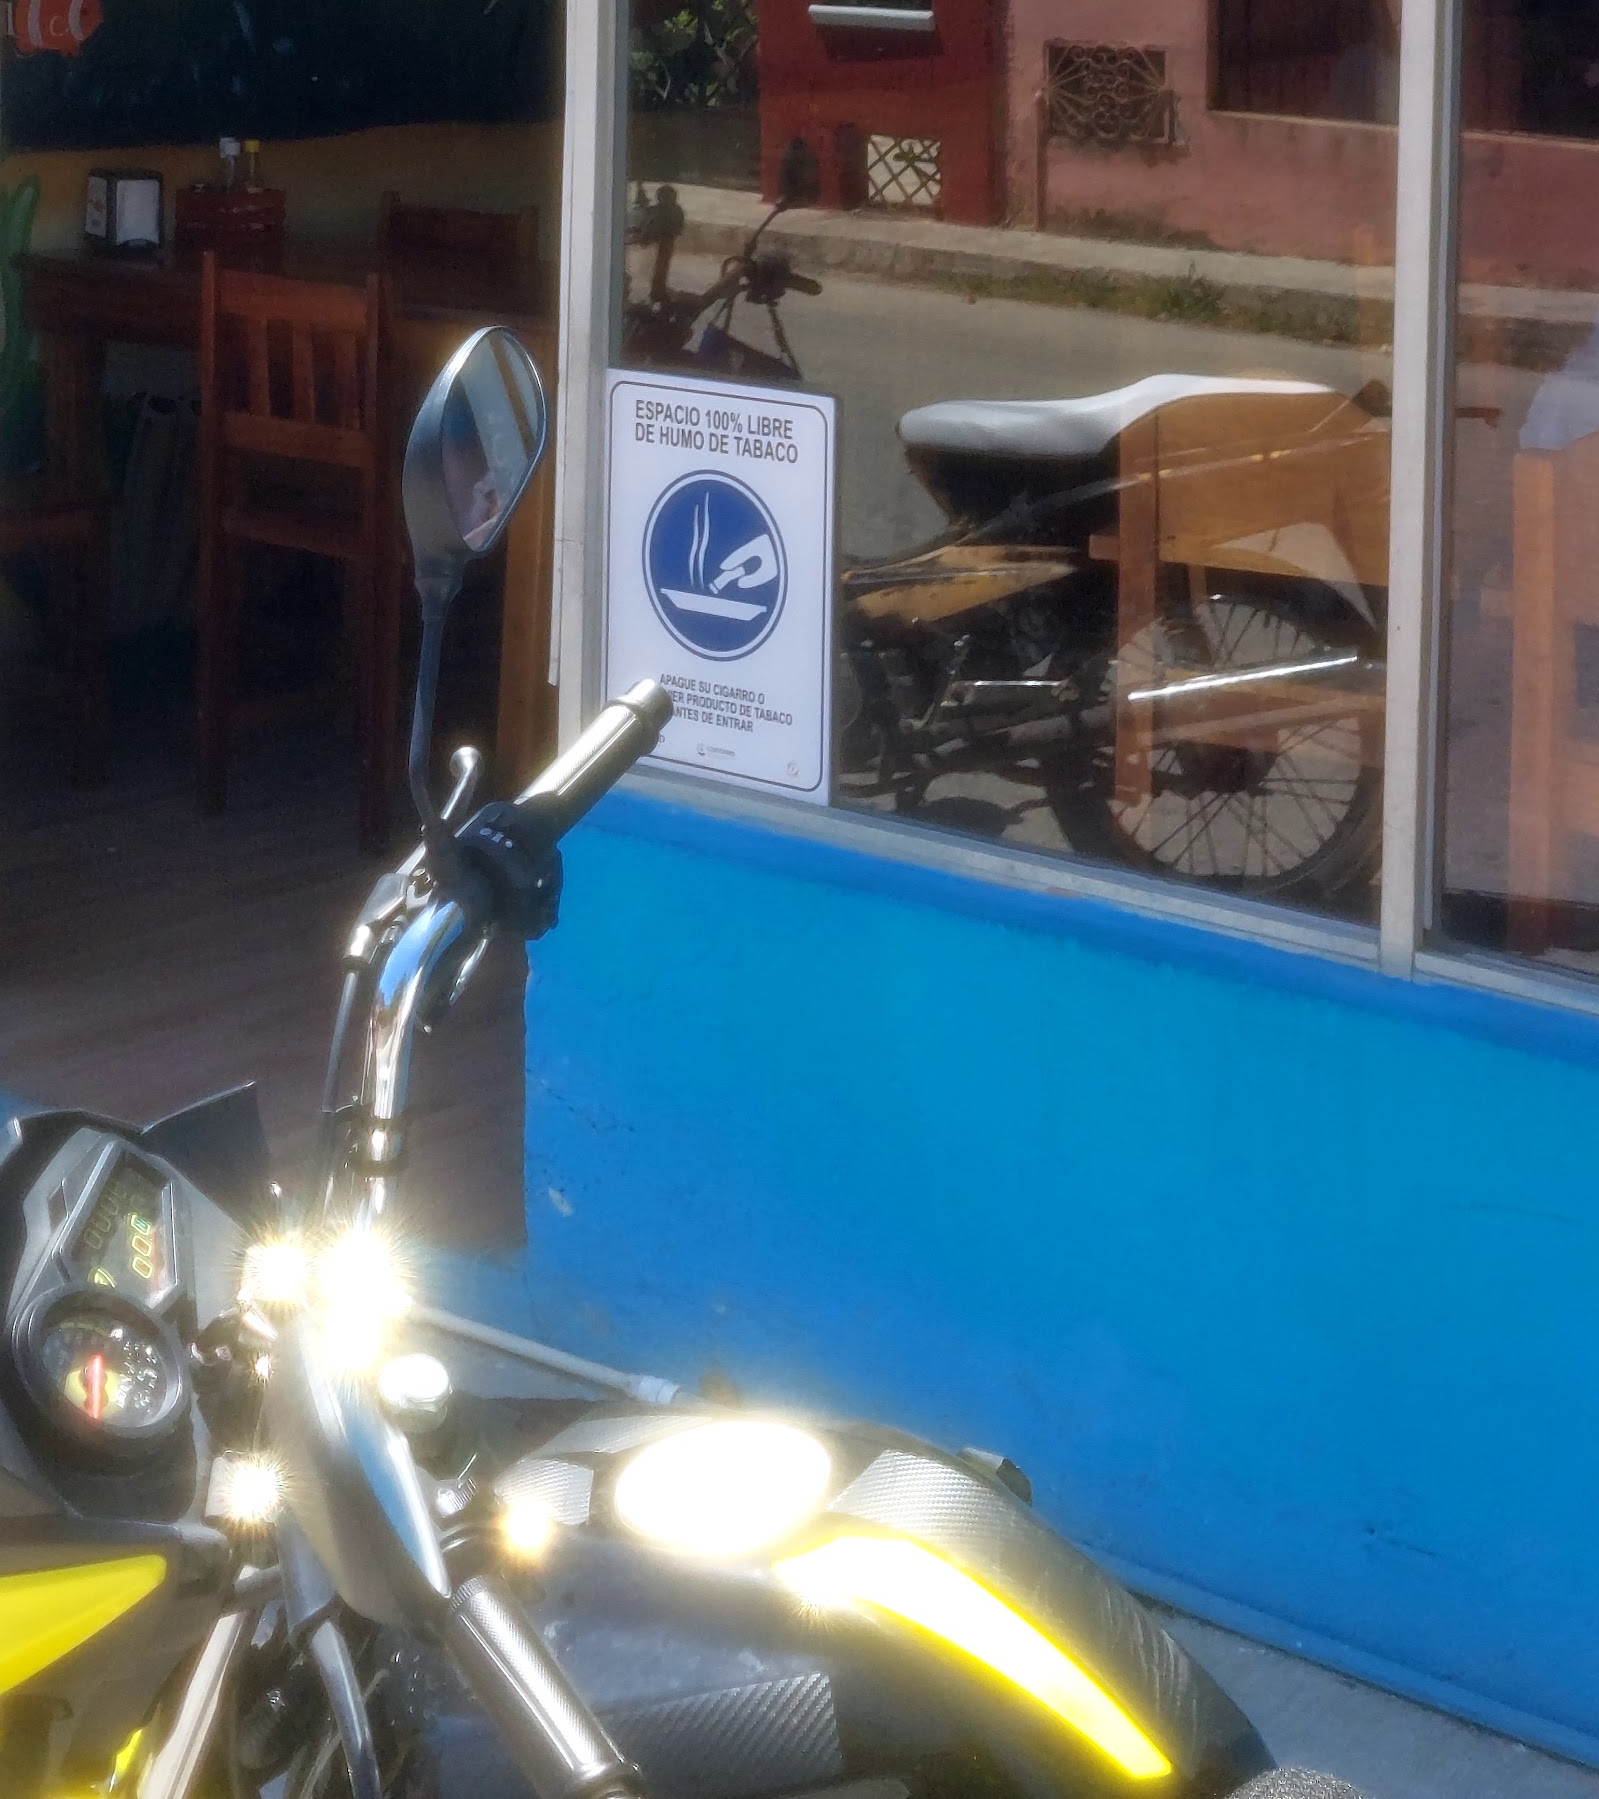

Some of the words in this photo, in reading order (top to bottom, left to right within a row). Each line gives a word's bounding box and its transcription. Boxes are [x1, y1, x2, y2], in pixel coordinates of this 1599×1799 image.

[635, 399, 700, 426] ESPACIO
[705, 410, 743, 433] 100%
[747, 415, 794, 440] LIBRE
[635, 422, 655, 444] DE
[659, 425, 705, 450] HUMO
[709, 433, 729, 454] DE
[733, 436, 799, 464] TABACO
[660, 673, 696, 692] APAGUE
[698, 680, 711, 694] SU
[713, 683, 756, 703] CIGARRO
[758, 693, 766, 705] O
[686, 692, 738, 715] PRODUCTO
[739, 704, 752, 718] DE
[755, 707, 793, 726] TABACO
[701, 712, 714, 725] DE
[716, 715, 754, 733] ENTRAR
